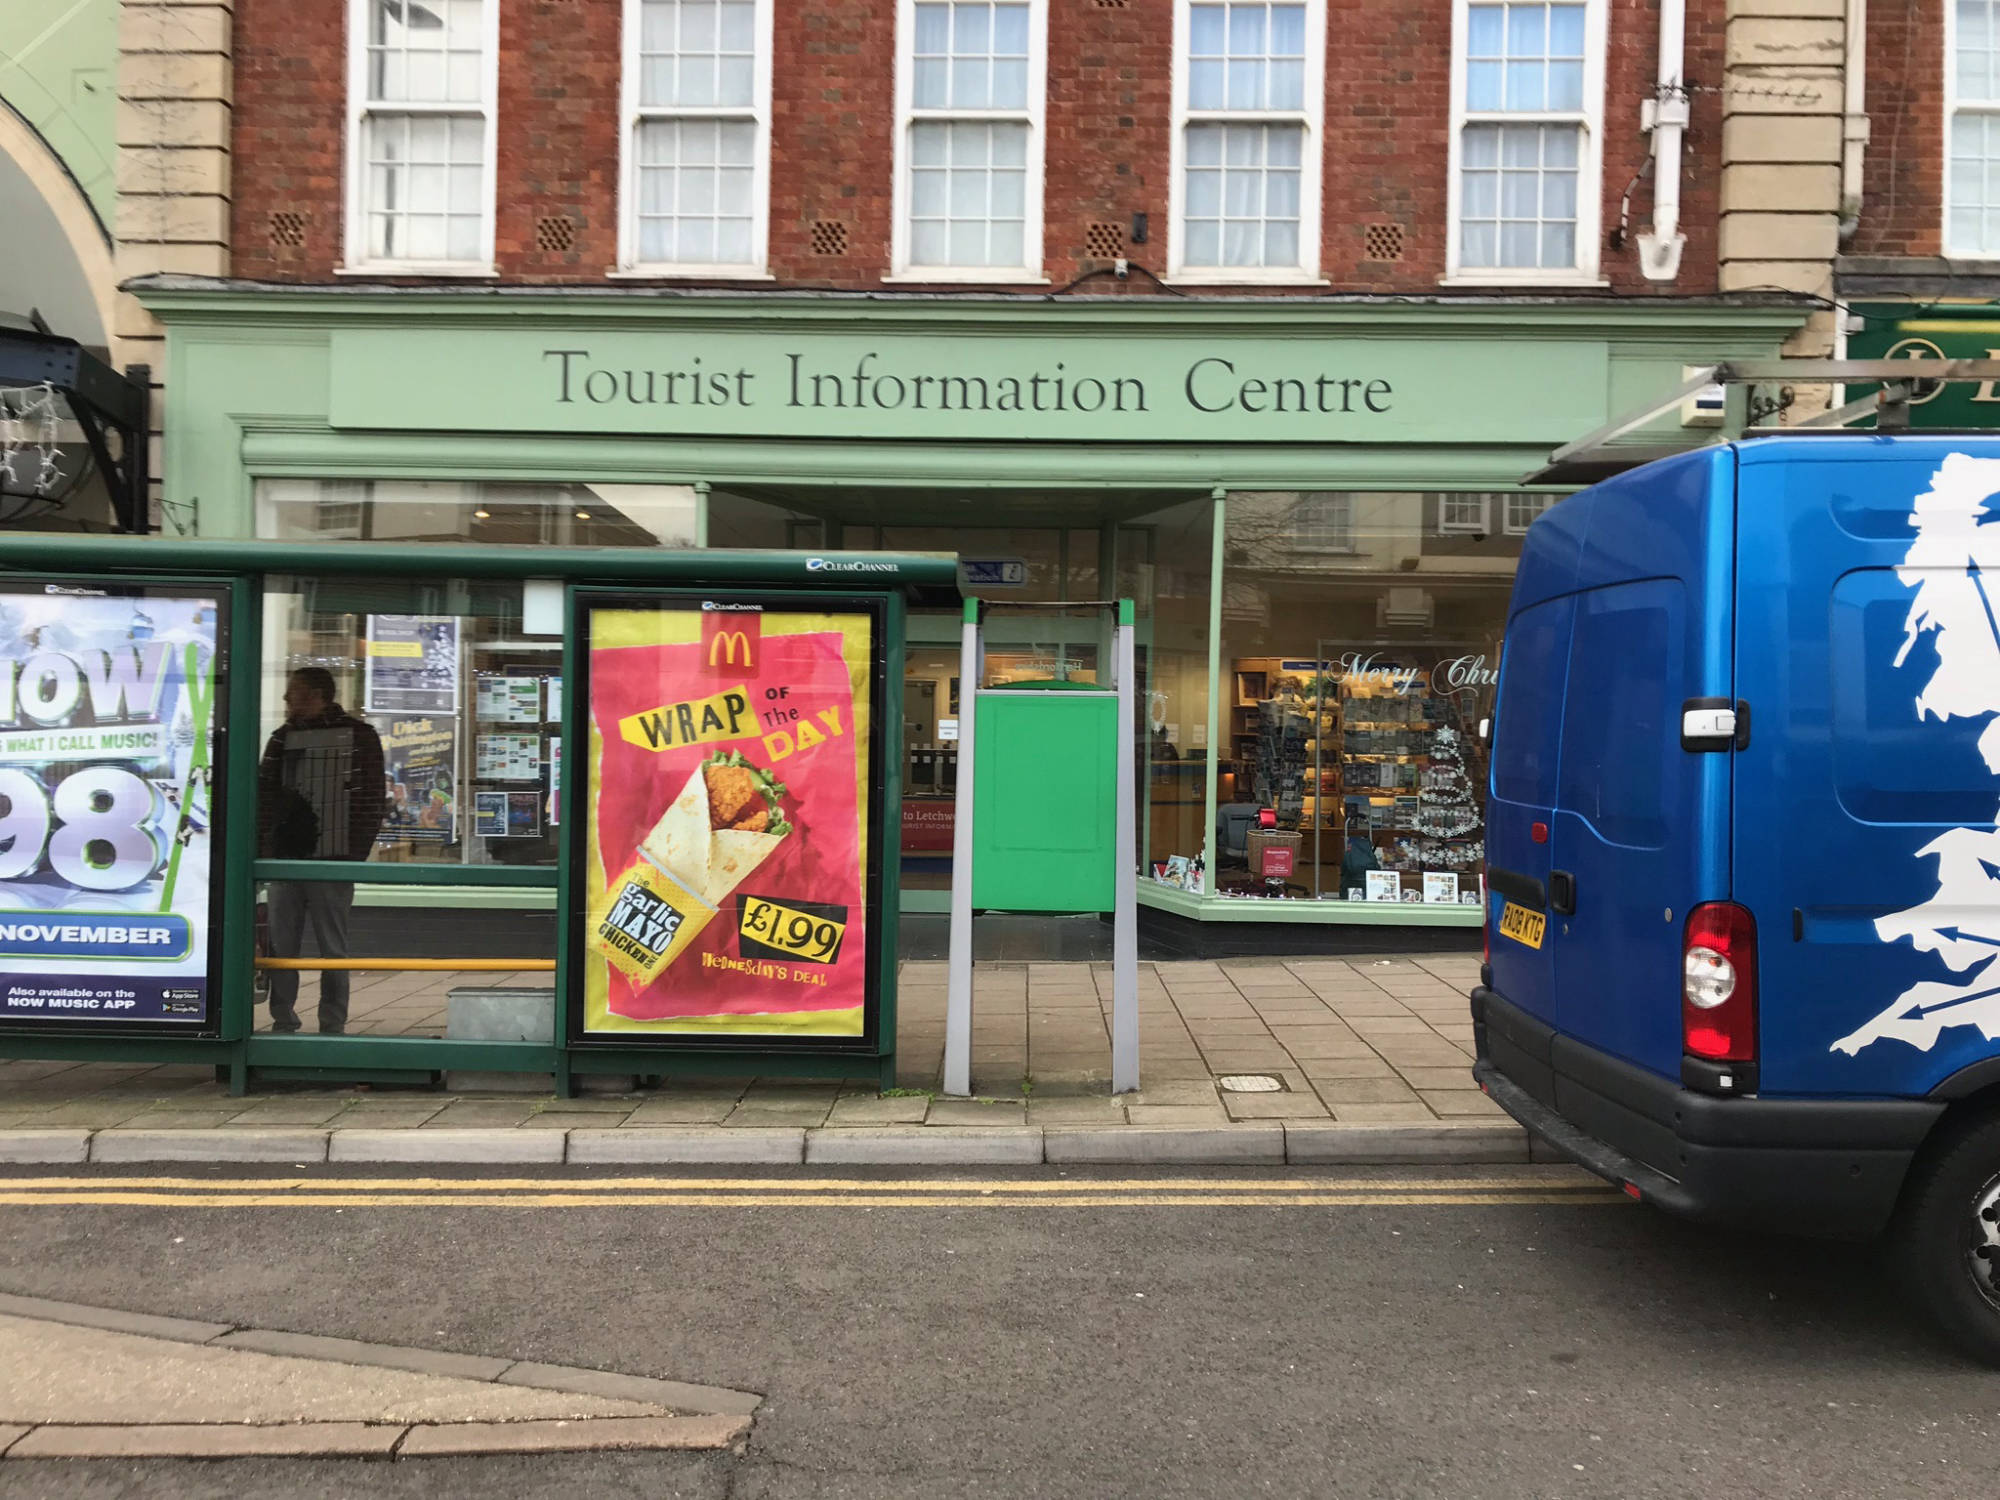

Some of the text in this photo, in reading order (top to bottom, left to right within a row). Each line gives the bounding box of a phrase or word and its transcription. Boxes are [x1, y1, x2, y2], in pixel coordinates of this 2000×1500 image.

[543, 350, 1393, 413] Tourist Information Centre
[1327, 651, 1420, 696] Merry
[638, 686, 790, 749] WRAP OF
[761, 704, 844, 763] DAY
[764, 707, 800, 729] The
[6, 732, 158, 752] WHAT I CALL MUSIC!
[608, 900, 674, 953] MAYO
[620, 882, 681, 932] garlic
[0, 924, 171, 945] NOVEMBER
[598, 922, 650, 964] CHICKEN
[744, 903, 838, 958] £1.99
[8, 987, 36, 996] Also
[38, 988, 93, 998] available
[114, 990, 136, 998] the
[793, 970, 827, 987] DEAL
[7, 998, 136, 1009] NOW MUSIC APP
